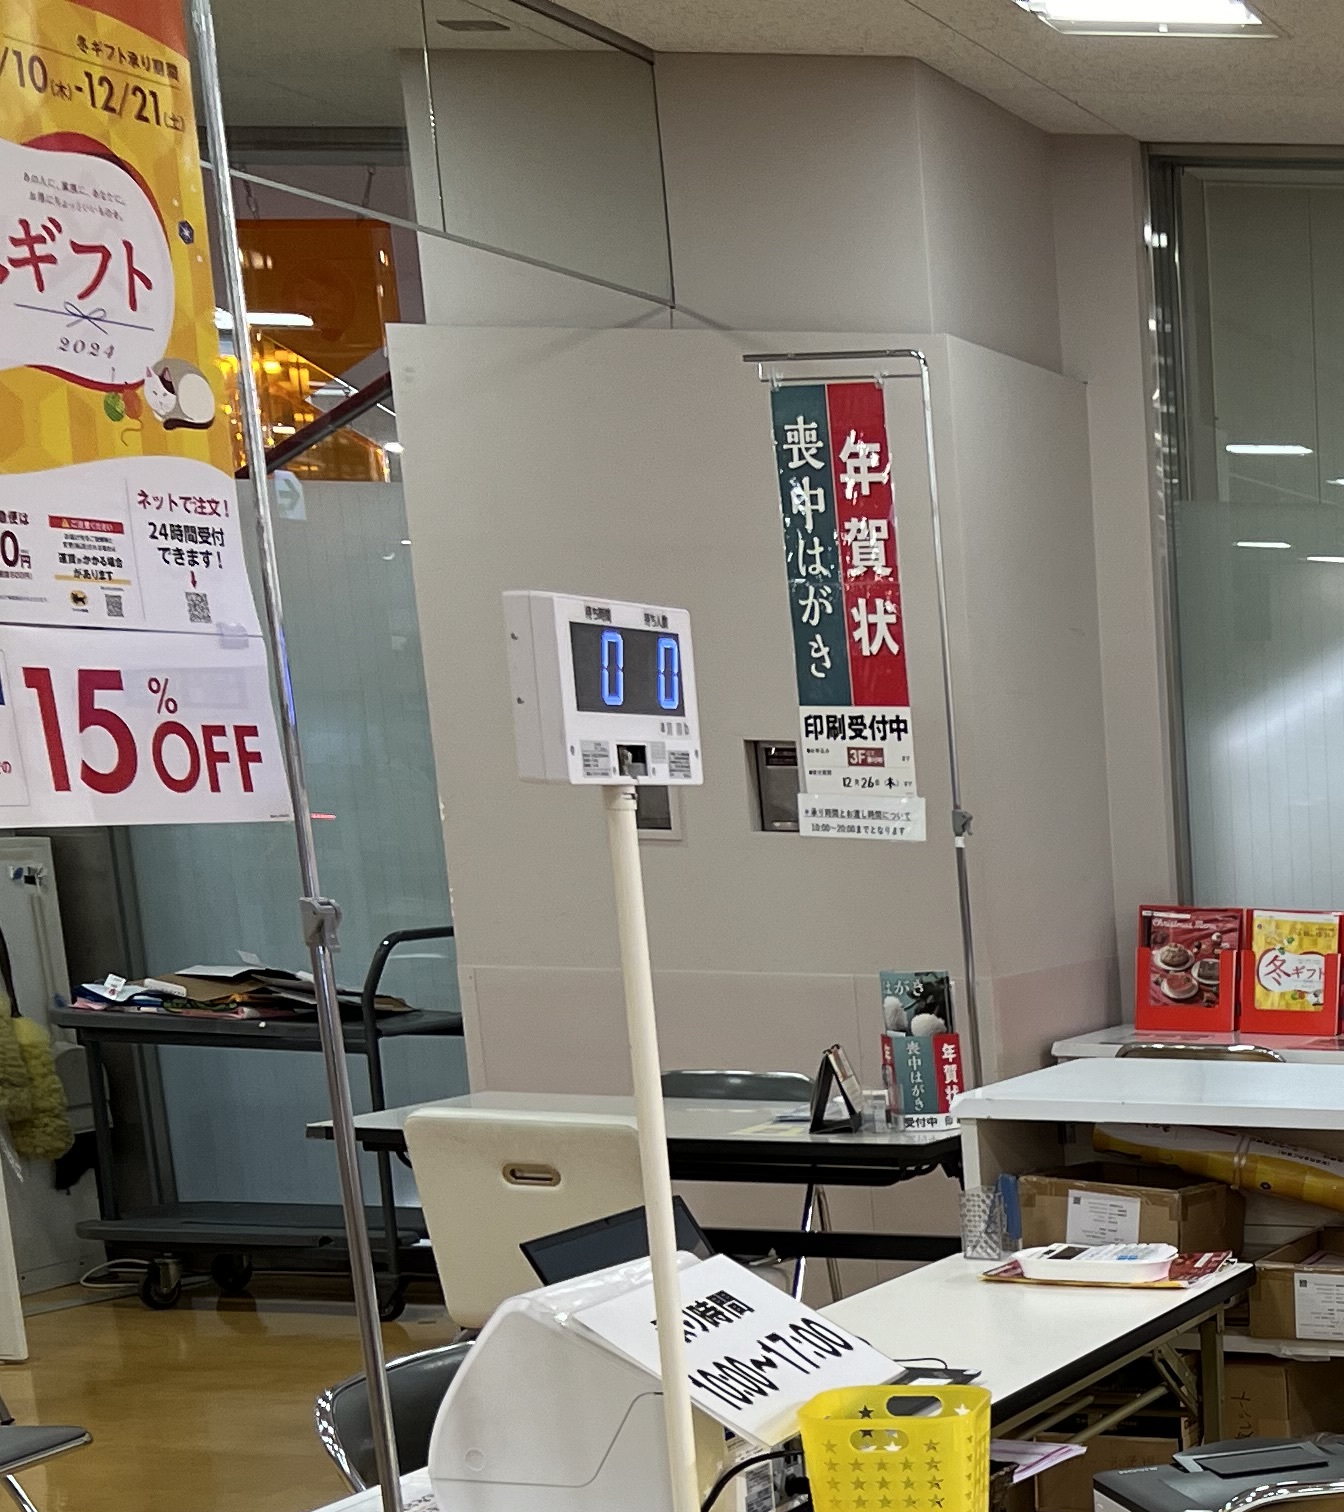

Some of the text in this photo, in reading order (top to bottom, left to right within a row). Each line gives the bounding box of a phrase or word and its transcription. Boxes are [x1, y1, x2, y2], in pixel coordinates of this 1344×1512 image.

[0, 216, 153, 311] ギフト
[57, 336, 115, 359] 2024
[137, 489, 231, 518] ネットで注文!
[148, 522, 226, 548] 24時間受付
[782, 415, 833, 679] 喪中はがき
[838, 429, 900, 657] 年賀状
[158, 546, 224, 569] できます!
[602, 629, 679, 710] 0 0
[22, 667, 263, 794] 15 % OFF
[804, 714, 909, 742] 印刷受付中
[849, 749, 866, 764] 3F
[1264, 954, 1325, 987] 冬ギフト
[883, 979, 925, 997] はがき
[906, 1040, 926, 1112] 喪中はがき
